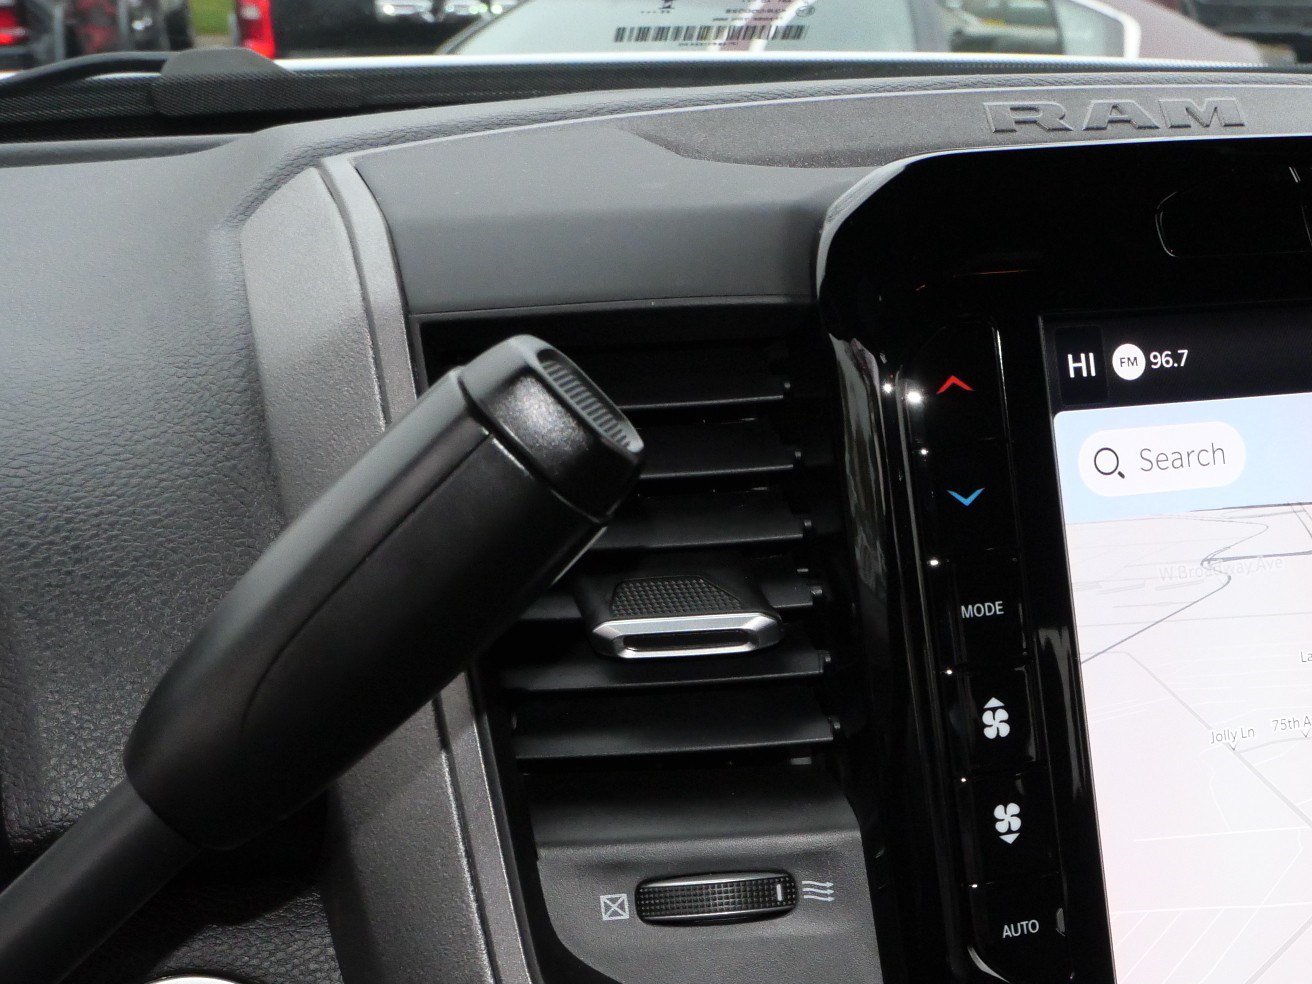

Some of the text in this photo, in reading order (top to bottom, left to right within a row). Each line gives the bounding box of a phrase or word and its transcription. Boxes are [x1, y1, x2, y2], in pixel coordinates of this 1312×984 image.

[983, 96, 1246, 133] RAM
[1067, 351, 1097, 379] HI
[1119, 349, 1189, 369] FM 96.7
[1139, 442, 1227, 472] Search
[1159, 556, 1284, 582] W Broadway Ave
[960, 600, 1005, 620] MODE
[1271, 717, 1300, 732] 75th
[1210, 726, 1256, 745] Jolly Ln
[1001, 919, 1040, 939] AUTO
